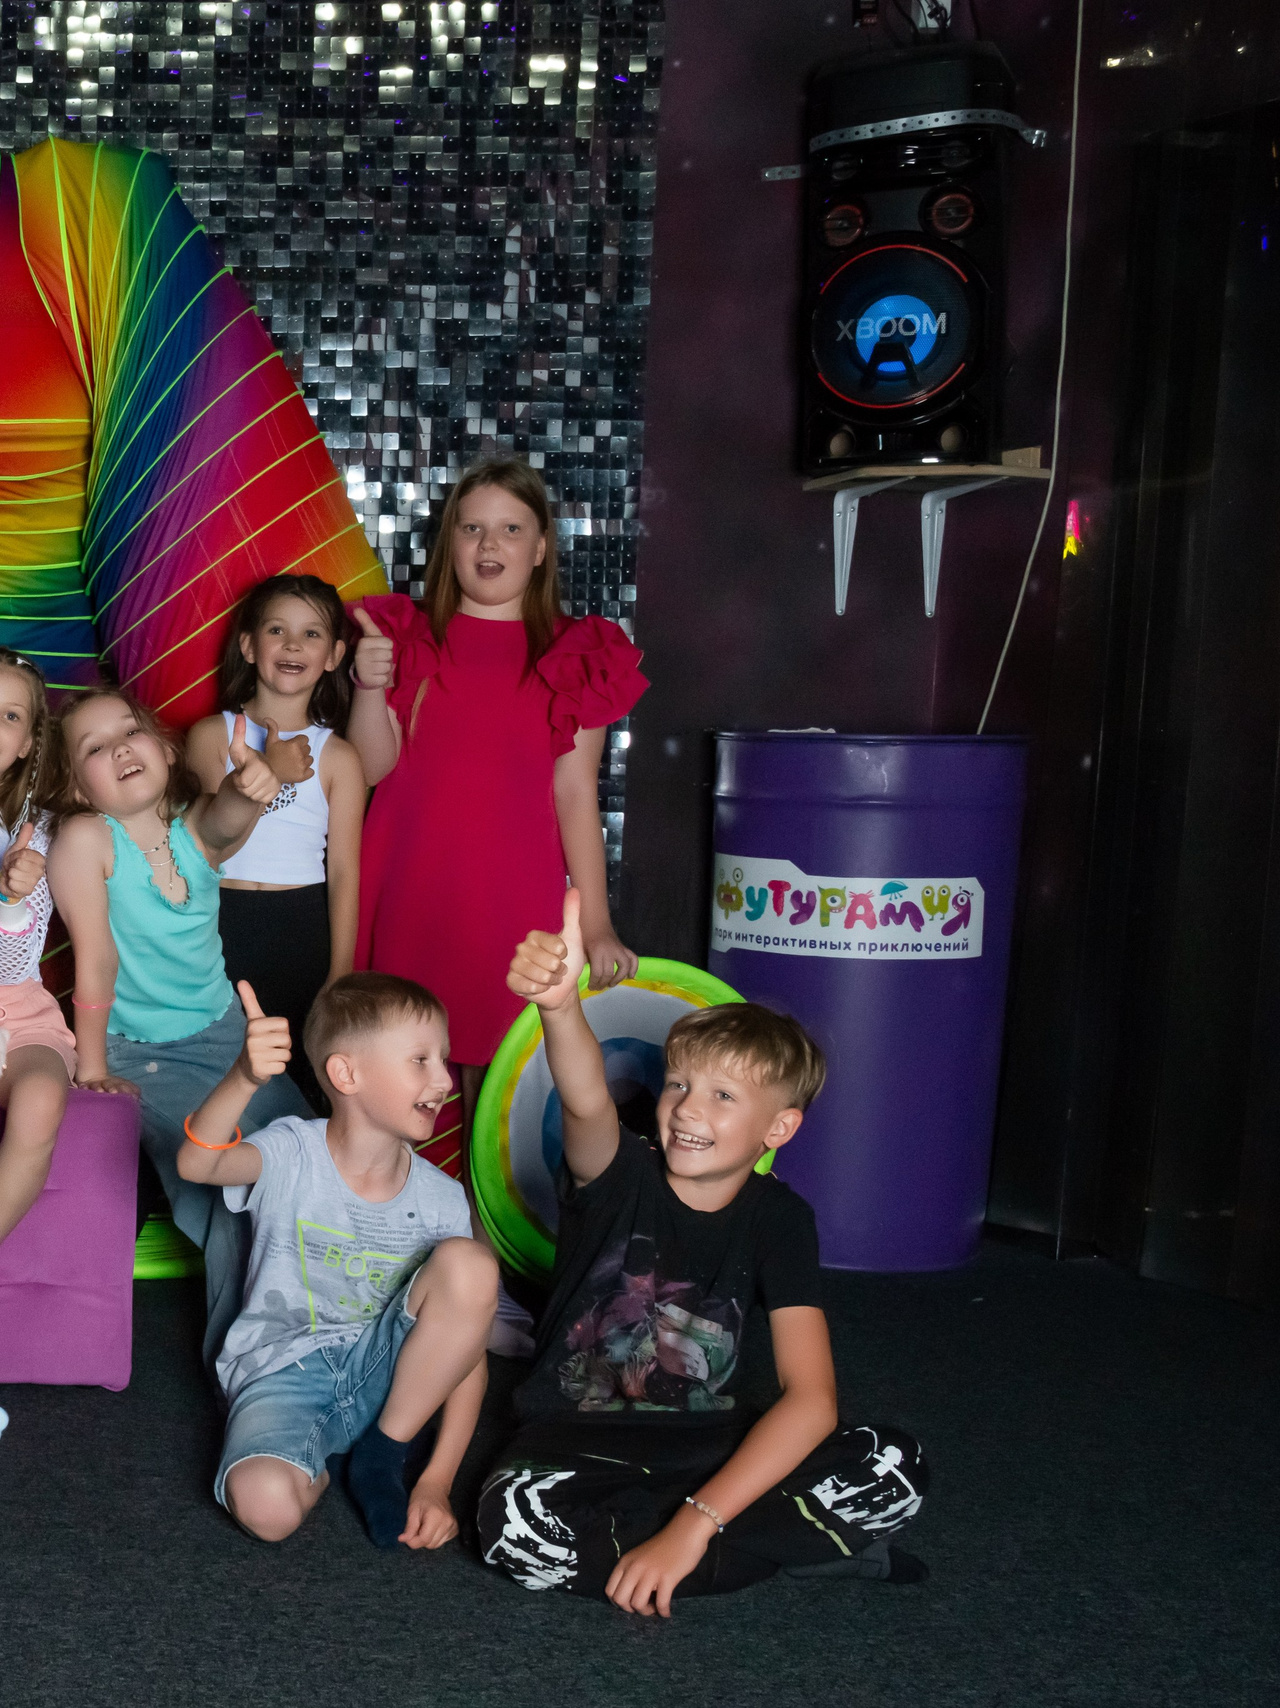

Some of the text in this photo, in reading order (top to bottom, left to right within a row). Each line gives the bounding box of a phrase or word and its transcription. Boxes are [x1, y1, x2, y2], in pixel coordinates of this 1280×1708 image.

[836, 312, 947, 342] XBOOM
[734, 931, 852, 951] интерактивных
[858, 937, 970, 954] приключений
